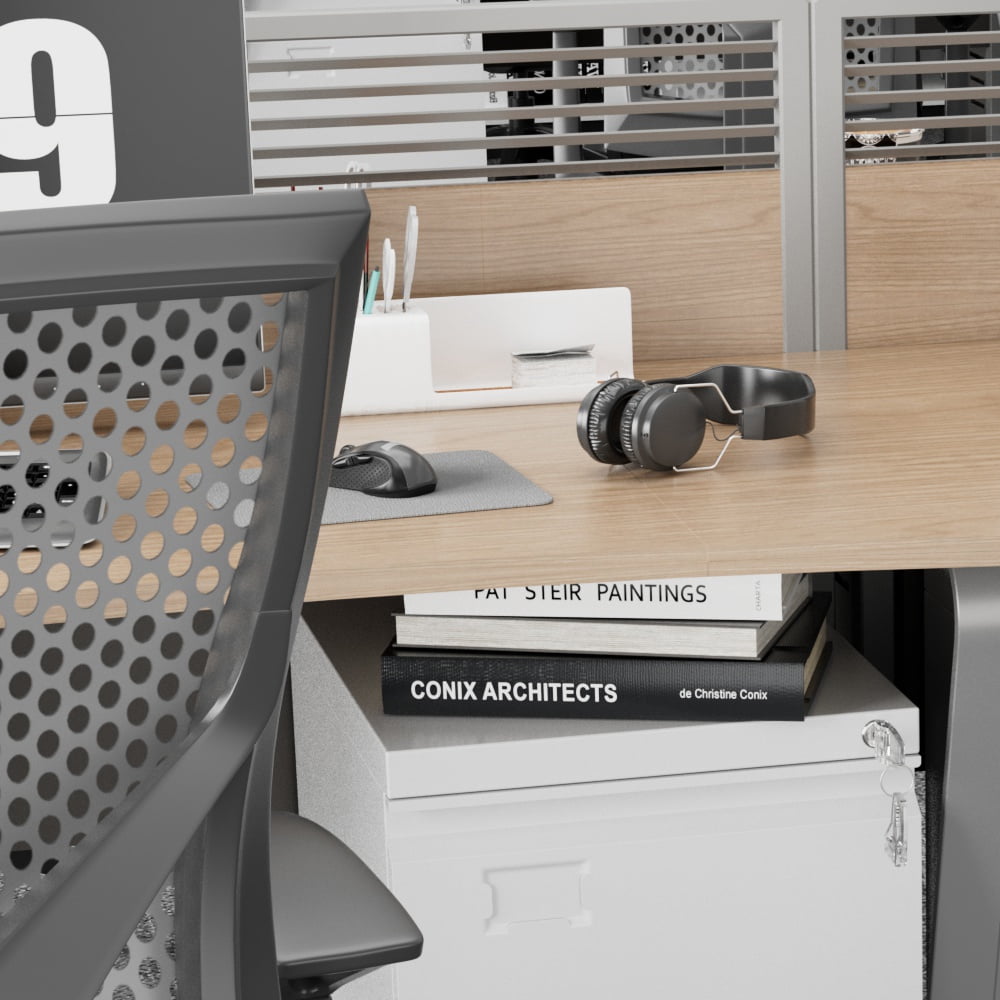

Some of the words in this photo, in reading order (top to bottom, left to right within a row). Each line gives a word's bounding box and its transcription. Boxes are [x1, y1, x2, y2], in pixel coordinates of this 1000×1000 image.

[597, 583, 707, 603] PAINTINGS
[410, 680, 477, 702] CONIX
[482, 681, 618, 703] ARCHITECTS
[679, 688, 692, 699] de
[694, 688, 738, 700] Christine
[740, 689, 768, 700] Conix
